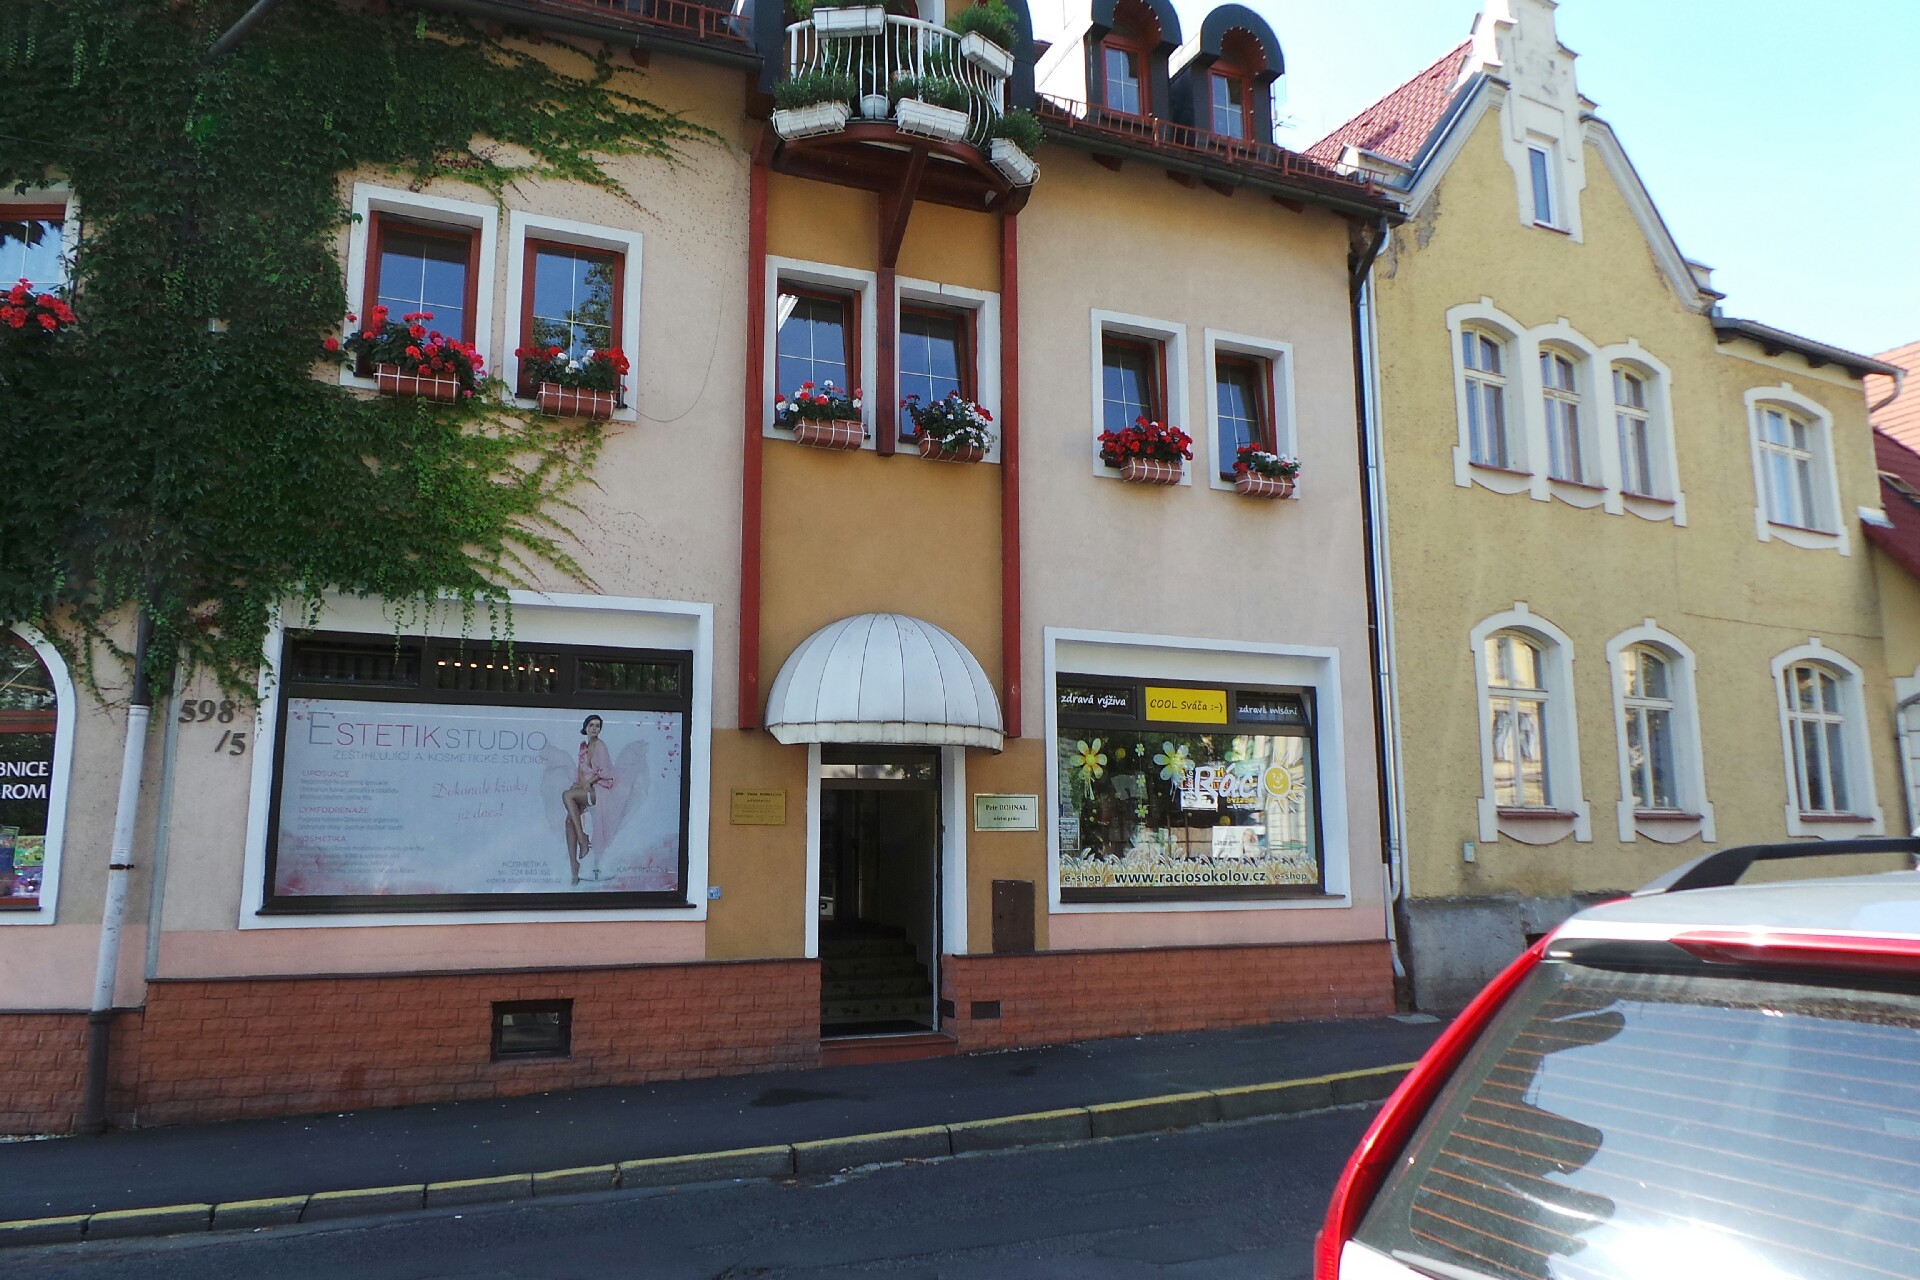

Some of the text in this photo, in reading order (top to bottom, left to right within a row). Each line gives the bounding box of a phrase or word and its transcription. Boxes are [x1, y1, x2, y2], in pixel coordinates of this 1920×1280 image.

[1060, 693, 1126, 709] zdravá výživa
[1150, 698, 1178, 709] COOL
[1181, 700, 1207, 711] Sváča
[1238, 704, 1268, 714] zdravé
[178, 699, 236, 723] 598
[215, 730, 246, 756] /5
[415, 752, 424, 761] A
[503, 753, 544, 765] STUDIO
[0, 783, 48, 800] ROM
[1064, 869, 1307, 885] e-shop www.raciosokolov.cz e-shop
